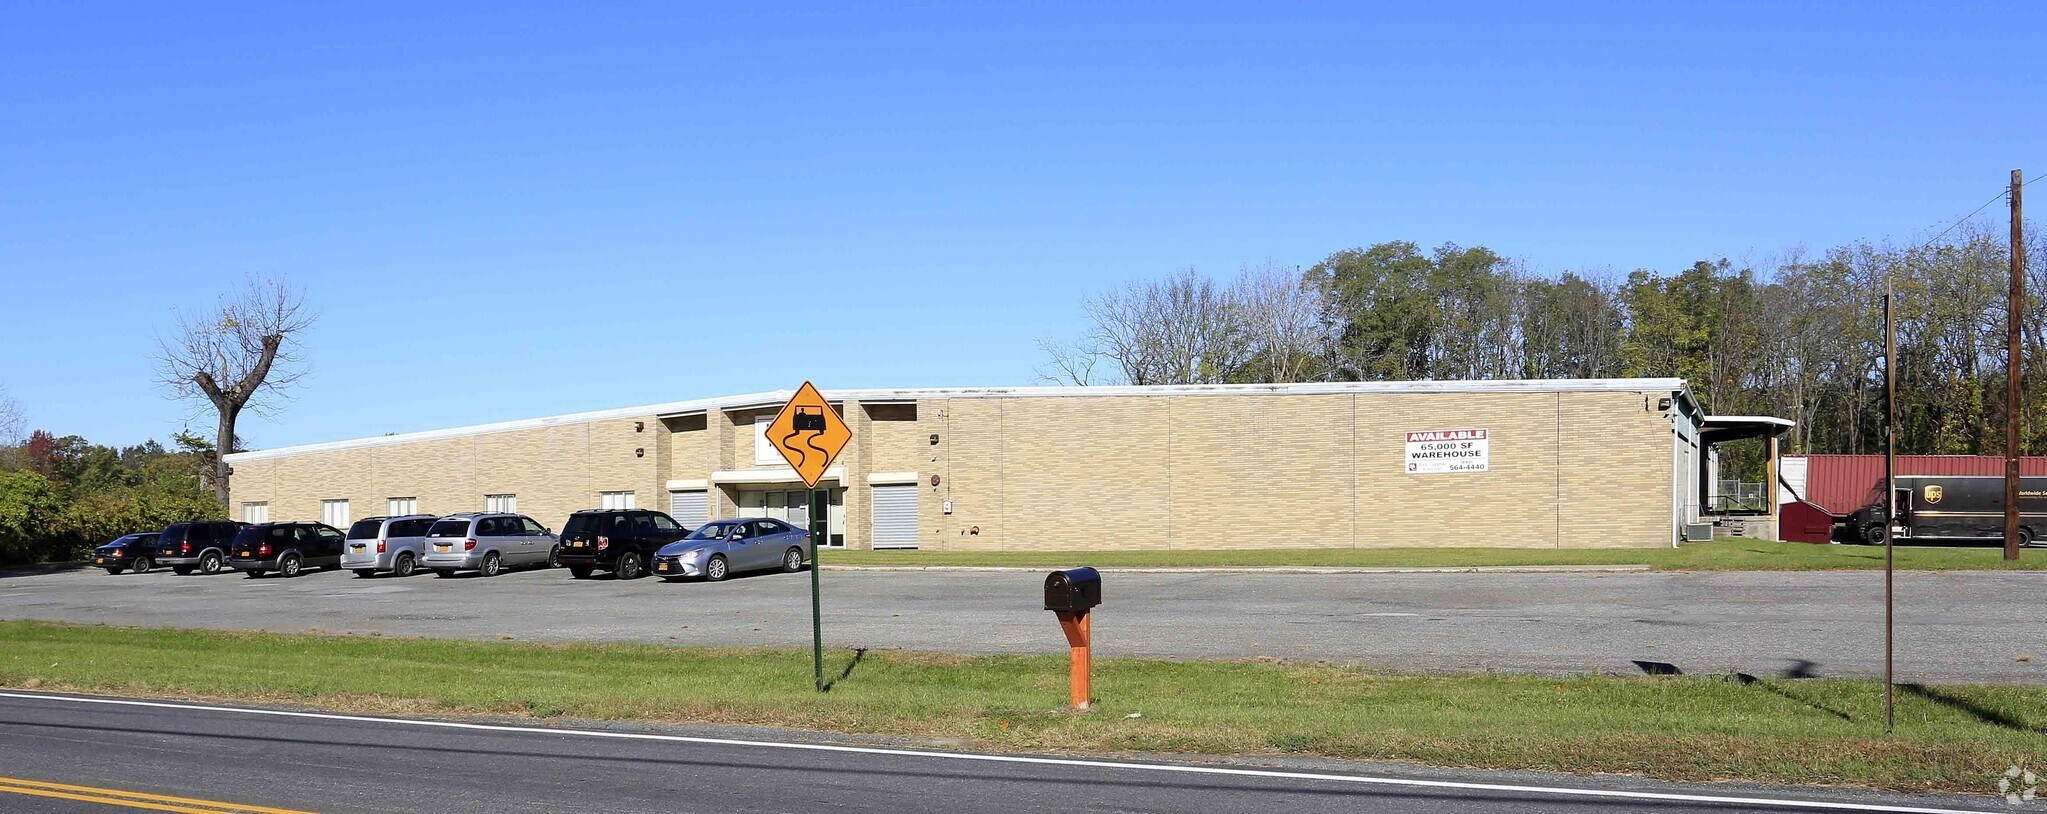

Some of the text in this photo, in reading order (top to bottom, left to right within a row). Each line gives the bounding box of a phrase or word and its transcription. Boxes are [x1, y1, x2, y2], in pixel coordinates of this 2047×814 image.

[1409, 430, 1484, 441] AVAILABLE
[1411, 450, 1481, 459] WAREHOUSE
[1925, 490, 1941, 501] ups
